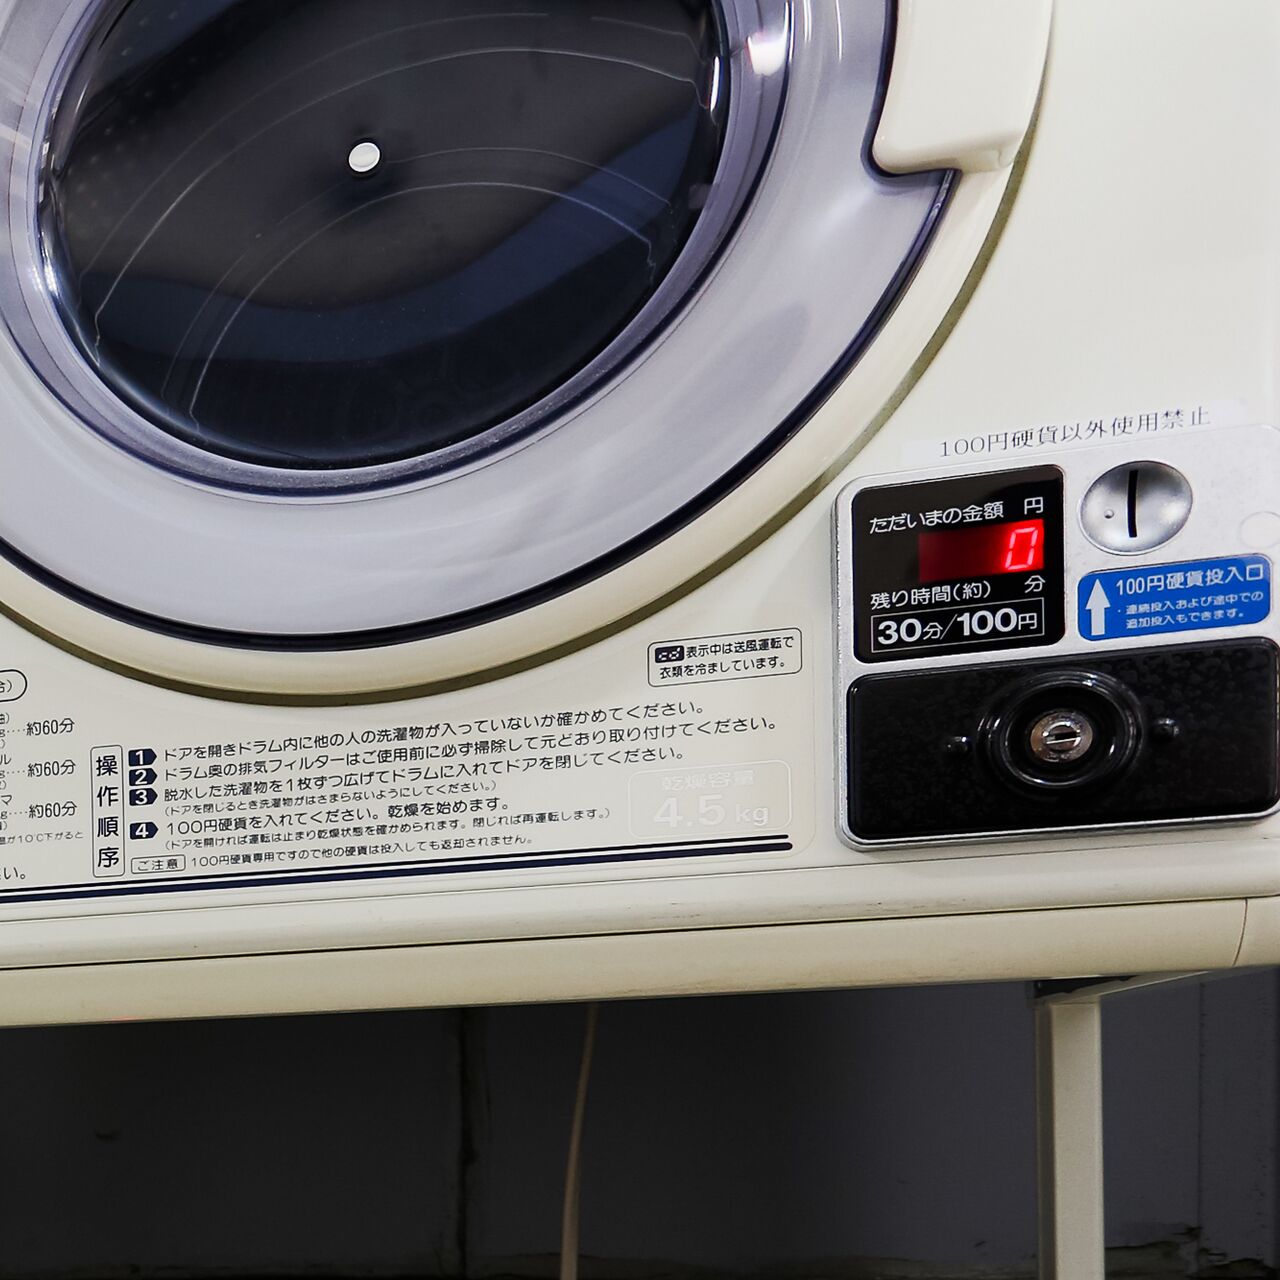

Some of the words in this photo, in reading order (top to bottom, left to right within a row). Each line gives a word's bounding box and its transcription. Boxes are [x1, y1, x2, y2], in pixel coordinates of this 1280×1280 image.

[939, 406, 1212, 458] 100円硬貨以外使用禁止
[869, 501, 1004, 534] ただいまの金額
[1024, 496, 1044, 514] 円
[1004, 526, 1039, 571] 0
[870, 581, 991, 610] 残り時間(約)
[1024, 576, 1045, 593] 分
[1116, 564, 1263, 596] 100円硬貨投入口
[877, 607, 1038, 645] 30分/100円
[1125, 608, 1244, 630] 追加投入もできます。
[686, 636, 795, 659] 表示中は送風運転で
[659, 655, 786, 680] 衣類を冷ましています。
[26, 717, 75, 736] 約60分
[164, 700, 704, 762] ドアを開きドラム内に他の人の洗濯物が入っていないか確かめてください。
[27, 759, 76, 777] 約60分
[164, 717, 776, 782] ドラム奥の排気フィルターはご使用前に必ず掃除して元どおり取り付けてください。
[164, 747, 684, 802] 脱水した洗濯物を1枚ずつ広げてドラムに入れてドアを閉じてください。
[28, 801, 77, 819] 約60分
[96, 755, 119, 869] 操作順序
[166, 797, 509, 836] 100円硬貨を入れてください。乾燥を始めます。
[137, 859, 179, 872] ご注意
[191, 834, 533, 867] 100円硬貨専用ですので他の硬貨は投入しても返却されません。
